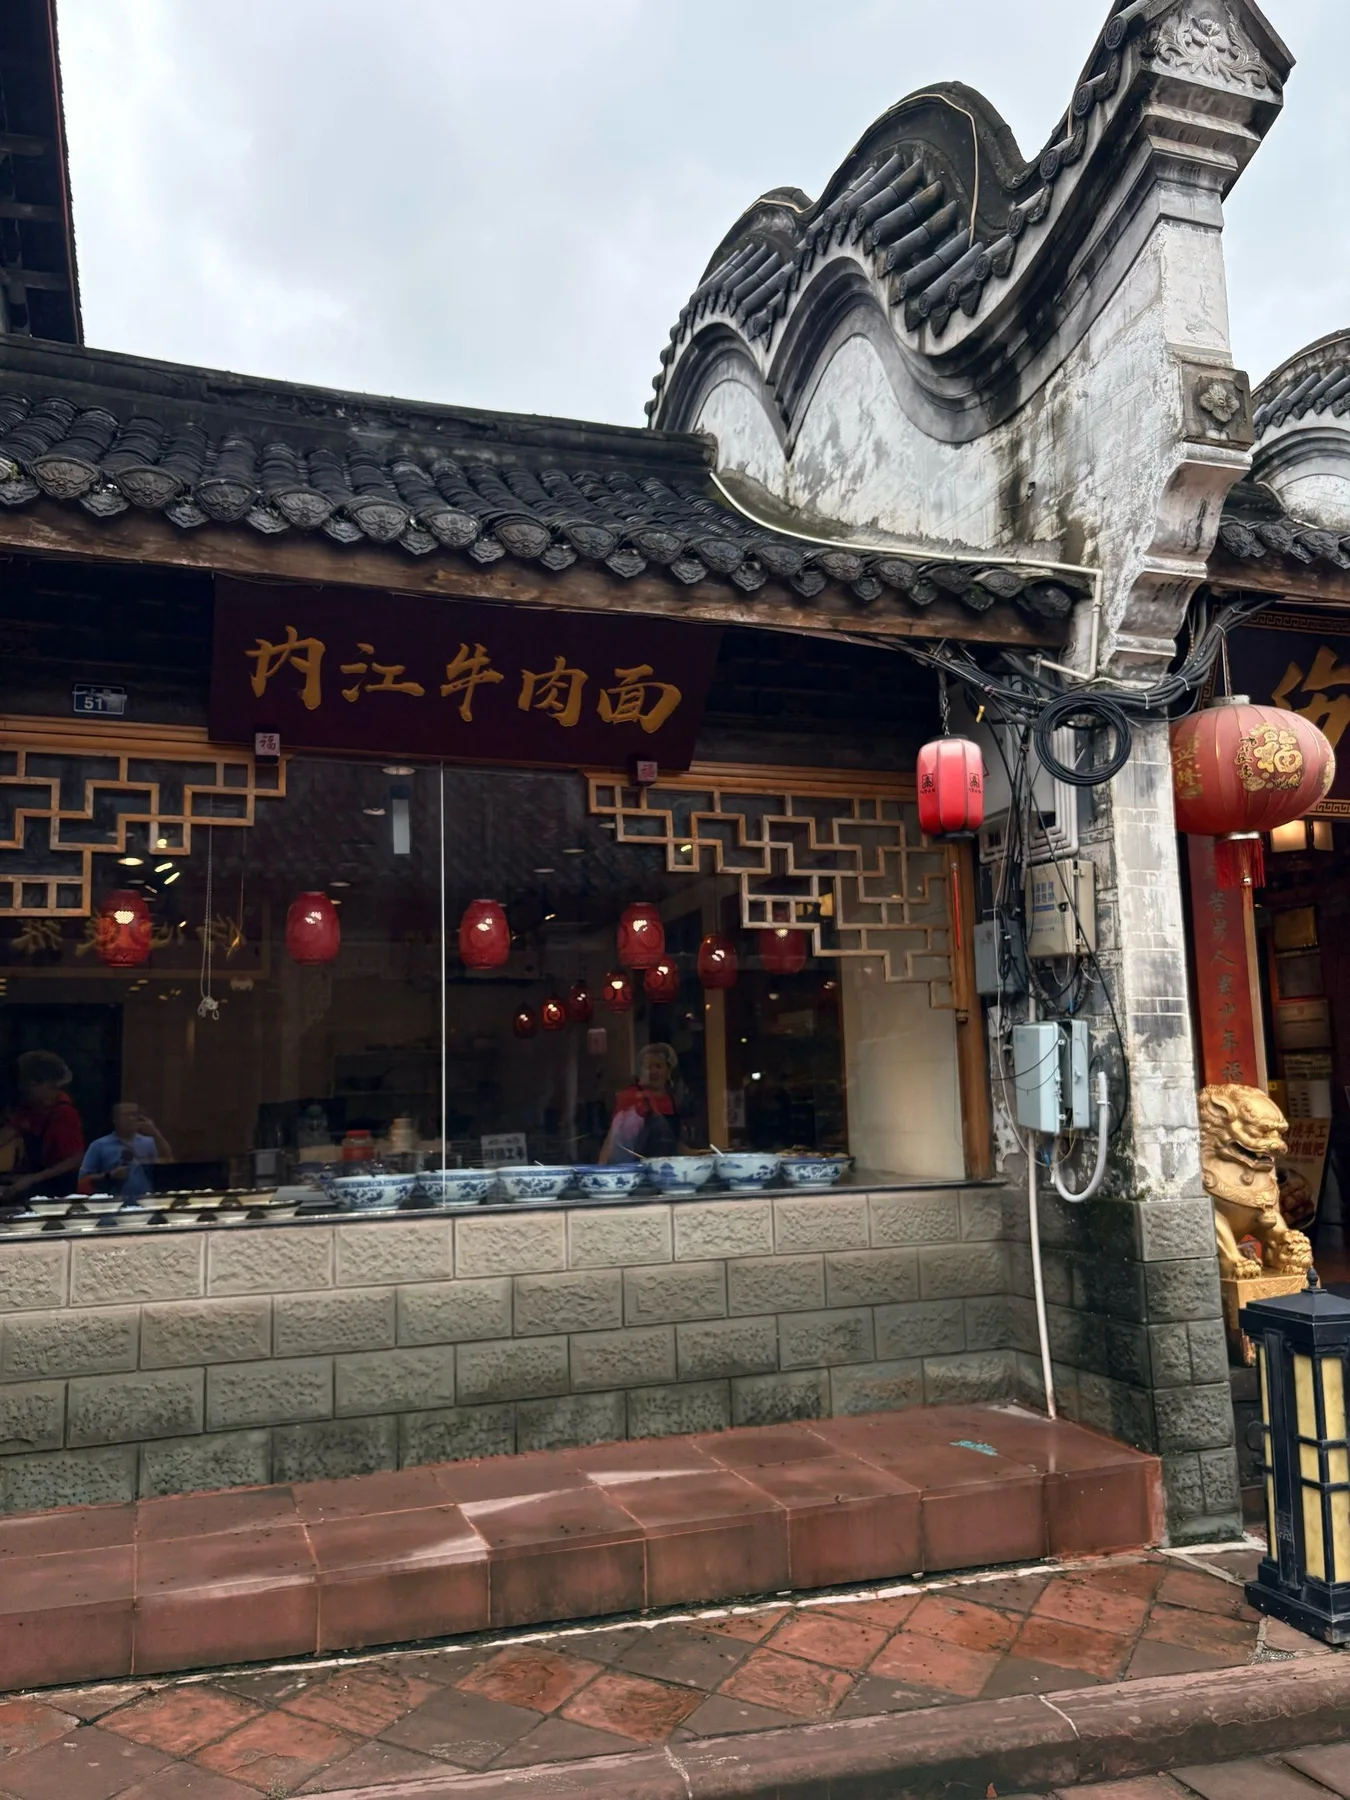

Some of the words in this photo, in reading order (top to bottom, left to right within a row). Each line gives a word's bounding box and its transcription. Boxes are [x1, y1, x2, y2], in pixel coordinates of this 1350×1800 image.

[244, 625, 683, 734] 内江牛肉面
